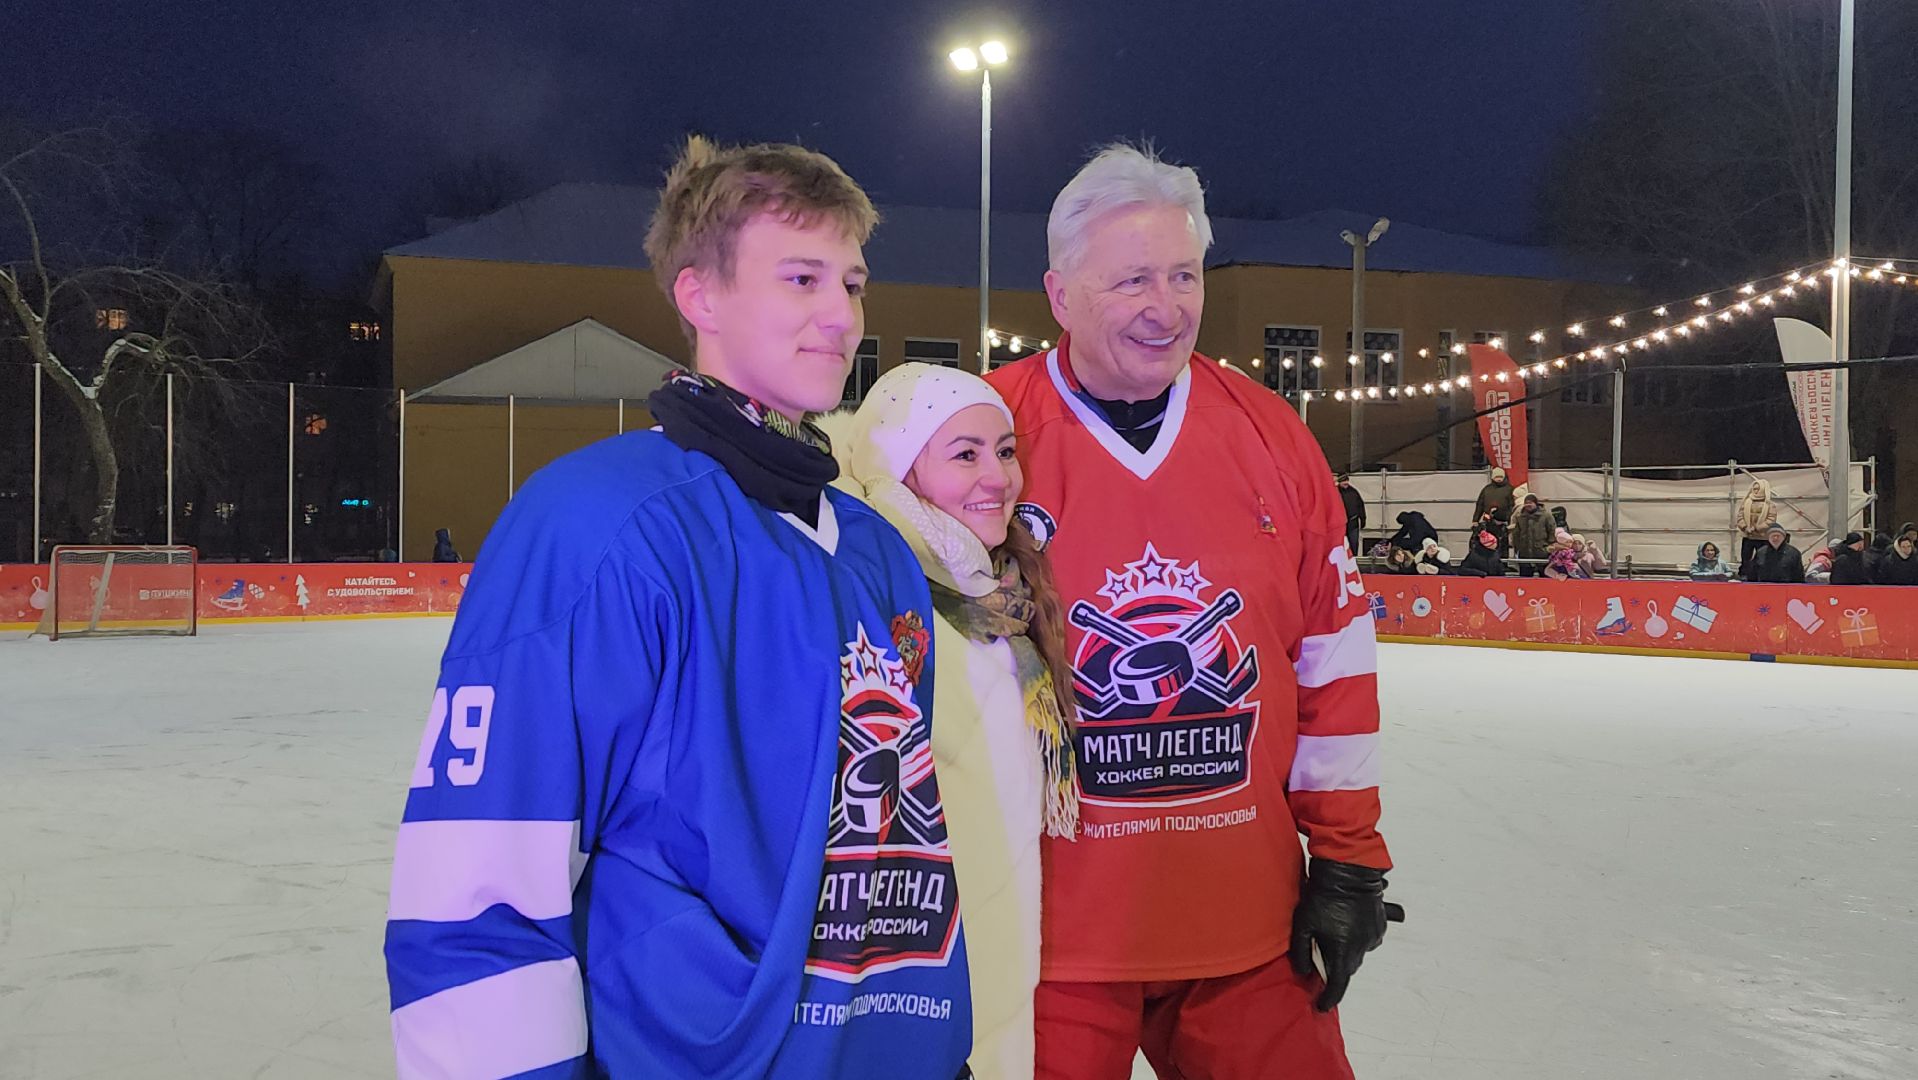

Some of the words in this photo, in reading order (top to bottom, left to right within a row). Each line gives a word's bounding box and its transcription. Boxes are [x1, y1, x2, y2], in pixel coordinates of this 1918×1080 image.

[345, 576, 397, 586] КАТАЙТЕСЬ
[1083, 731, 1151, 764] МАТЧ
[1156, 723, 1243, 759] ЛЕГЕНД
[1096, 765, 1164, 785] ХОККЕЯ
[1169, 759, 1240, 777] РОССИИ
[1083, 816, 1161, 839] ЖИТЕЛЯМИ
[1165, 805, 1257, 833] ПОДМОСКОВЬЯ
[817, 871, 875, 912] АТЧ
